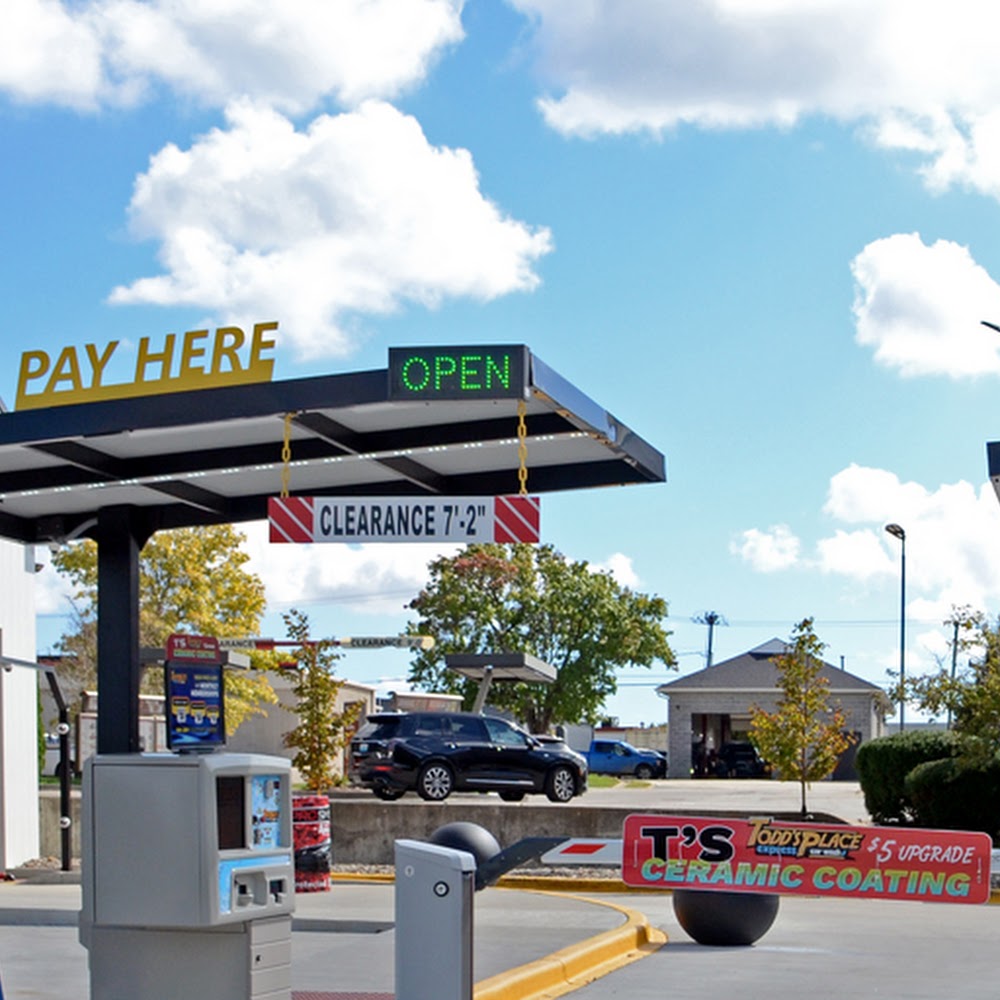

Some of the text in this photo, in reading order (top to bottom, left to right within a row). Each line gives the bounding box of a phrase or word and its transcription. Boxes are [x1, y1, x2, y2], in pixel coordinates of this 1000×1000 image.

[15, 320, 278, 404] PAY HERE
[402, 355, 509, 391] OPEN
[320, 504, 486, 537] CLEARANCE 7'-2"
[641, 825, 734, 864] T'S
[796, 830, 864, 858] PLACE
[867, 837, 976, 865] $5 UPGRADE
[641, 857, 972, 898] CERAMIC COATING
